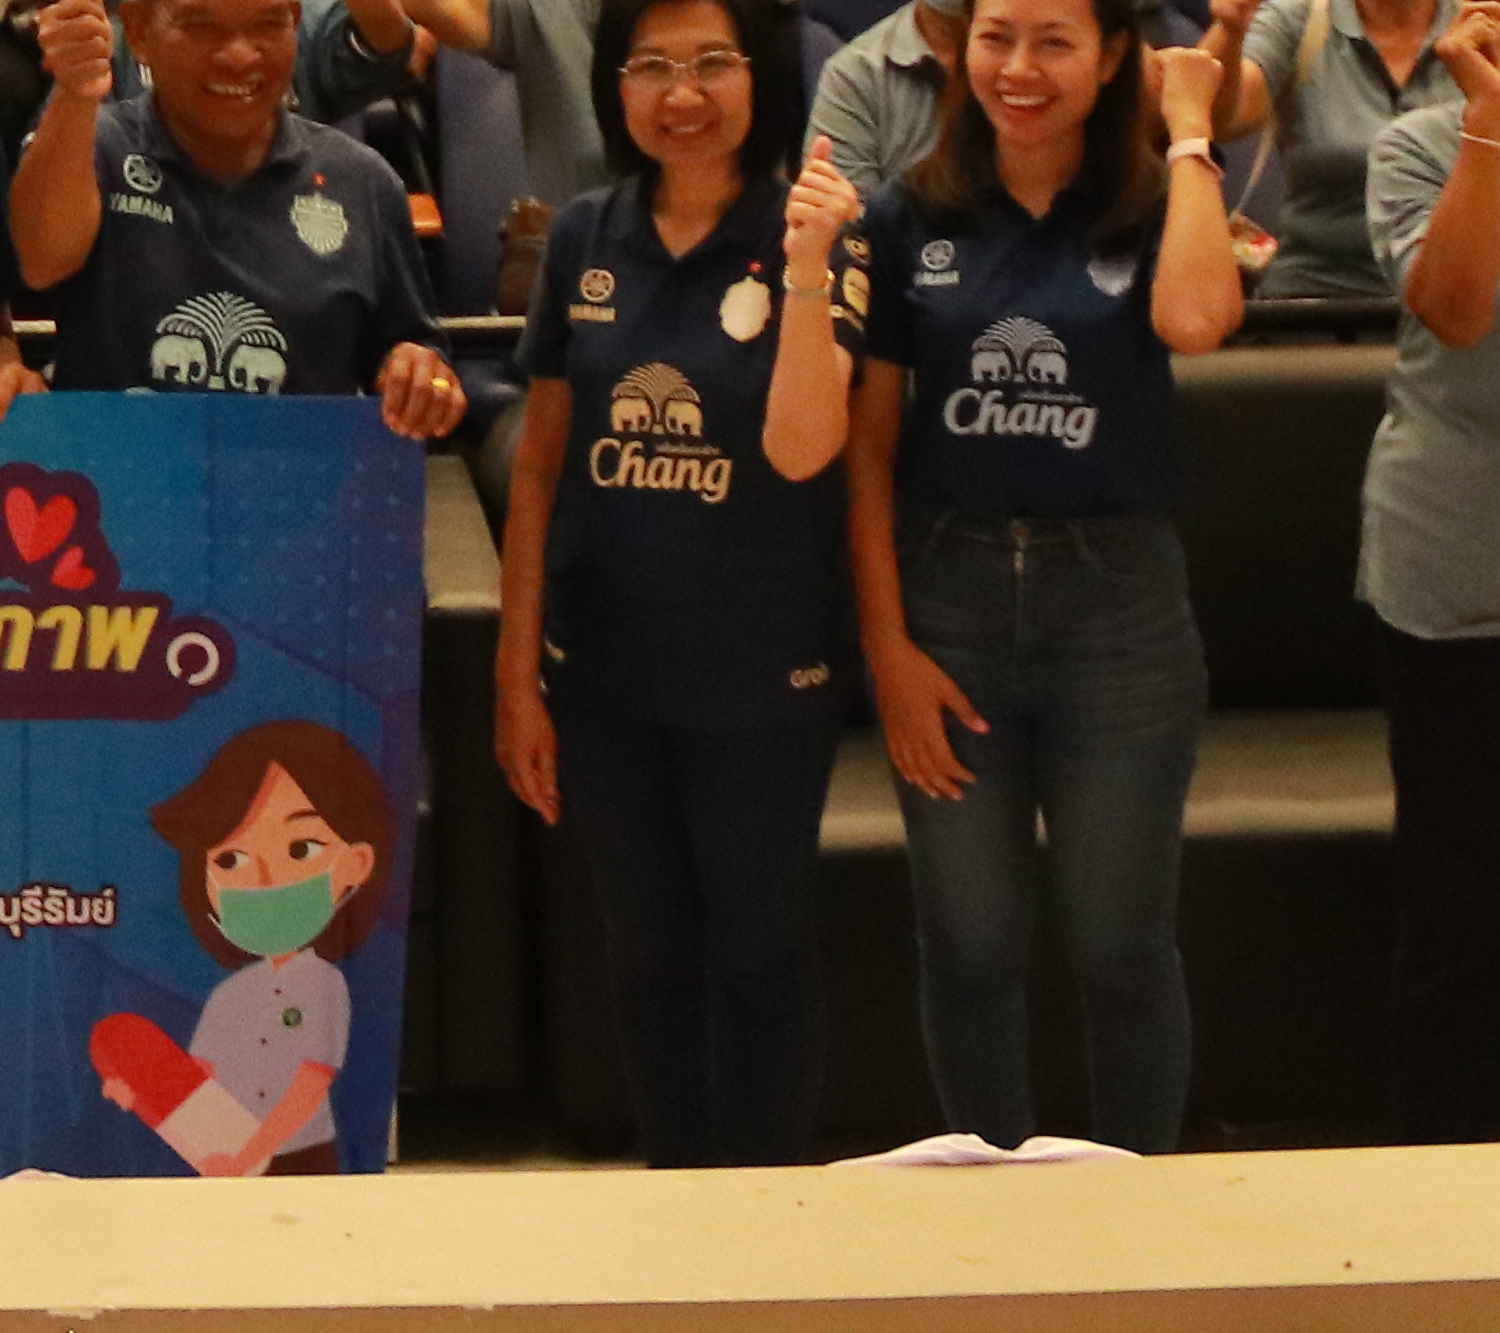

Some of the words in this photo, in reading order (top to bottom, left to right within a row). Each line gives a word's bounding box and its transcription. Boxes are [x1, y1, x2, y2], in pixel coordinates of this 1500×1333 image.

[110, 192, 174, 224] YAMAHA
[943, 388, 1098, 450] Chang
[590, 436, 733, 504] Chang
